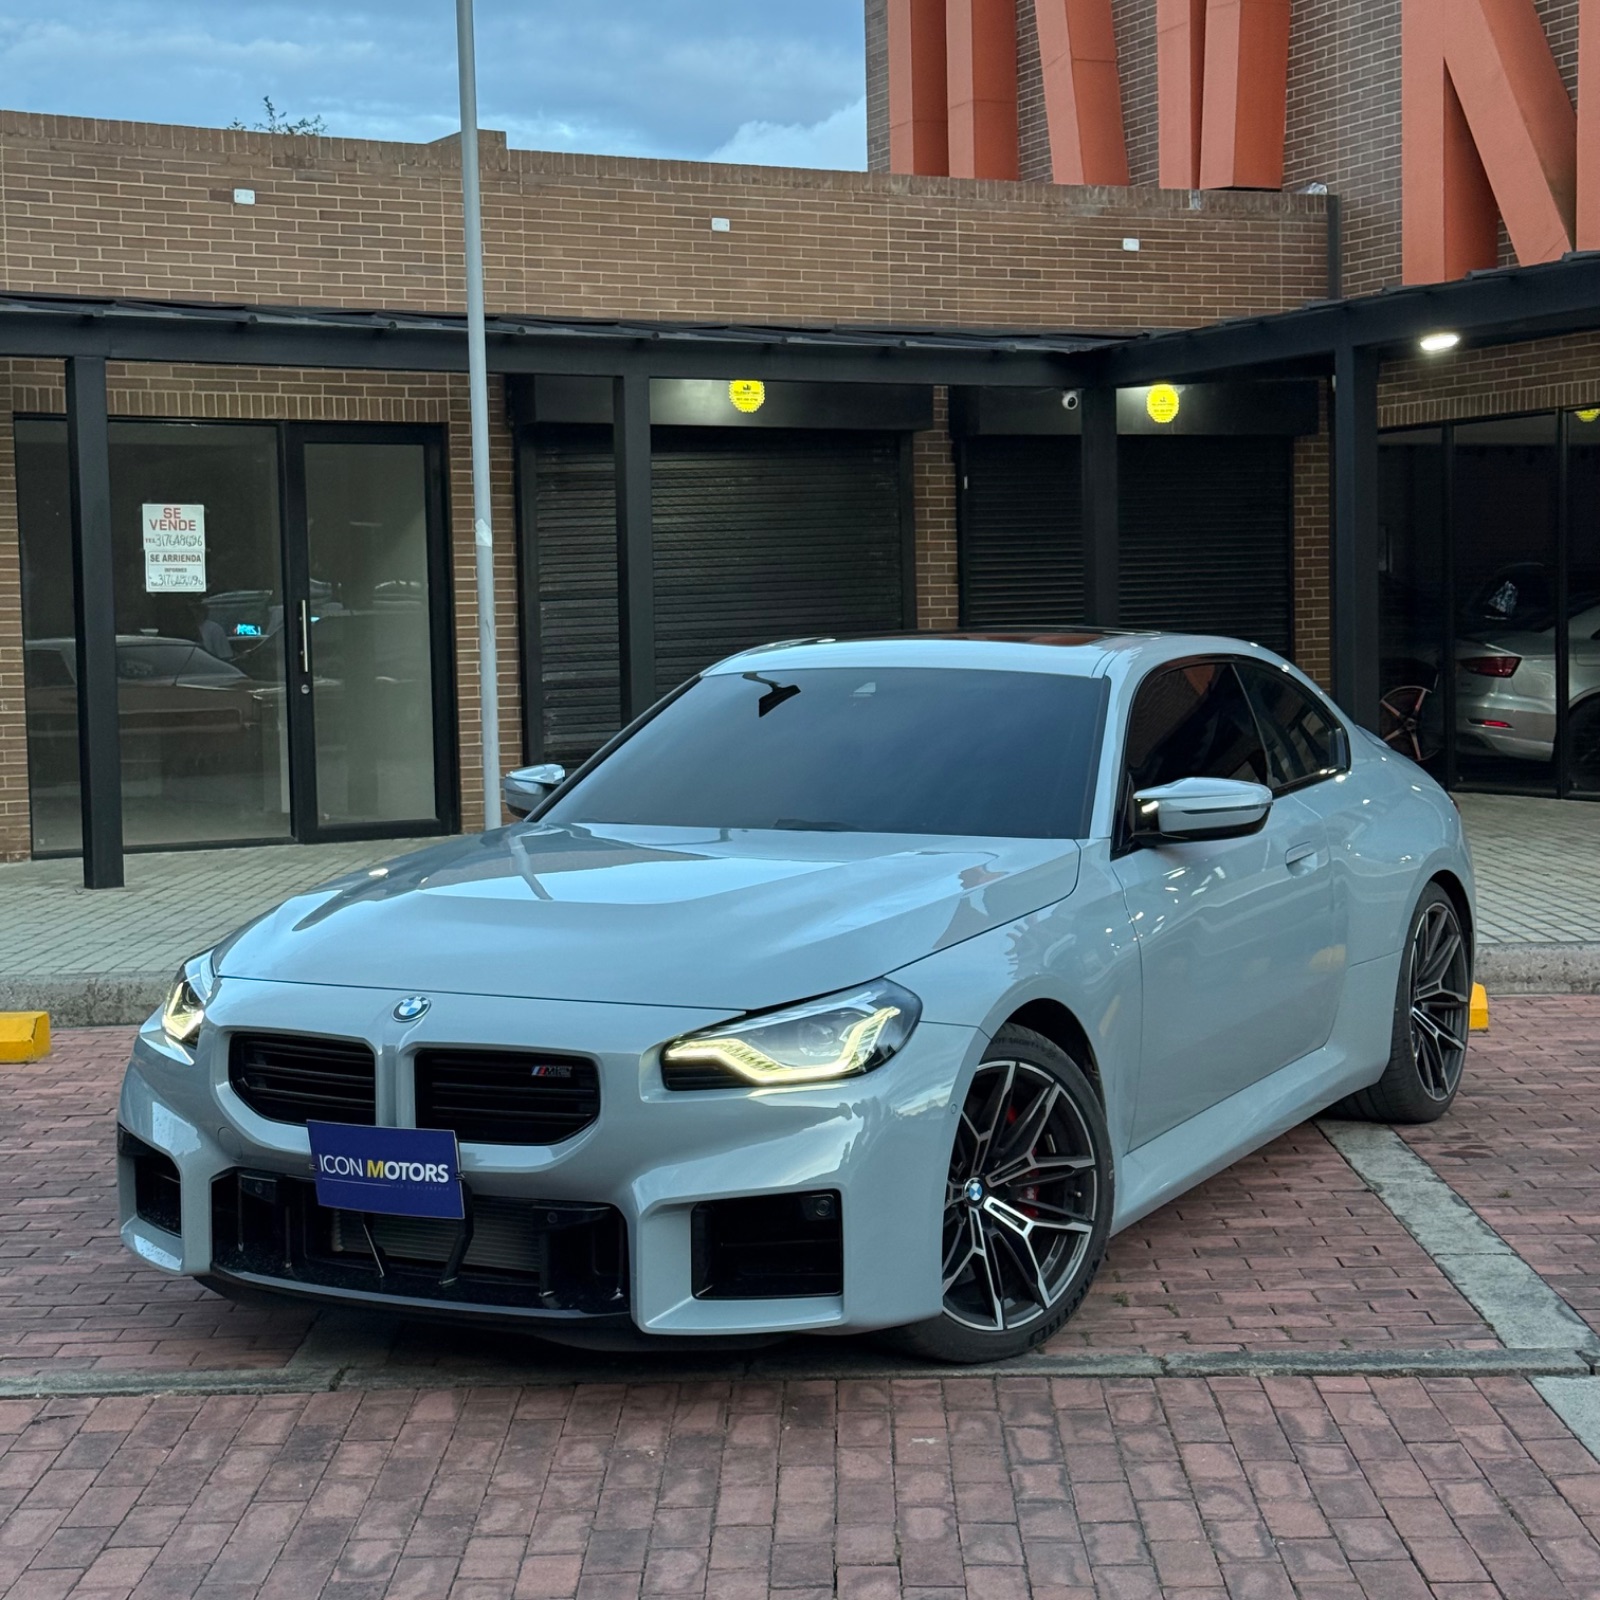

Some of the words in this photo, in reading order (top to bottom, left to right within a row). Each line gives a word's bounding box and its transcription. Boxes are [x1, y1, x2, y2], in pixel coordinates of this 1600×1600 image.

[163, 507, 181, 519] SE
[149, 519, 197, 531] VENDE
[150, 554, 160, 562] SE
[162, 554, 202, 562] ARRIENDA
[318, 1153, 364, 1178] ICON
[367, 1159, 449, 1183] MOTORS
